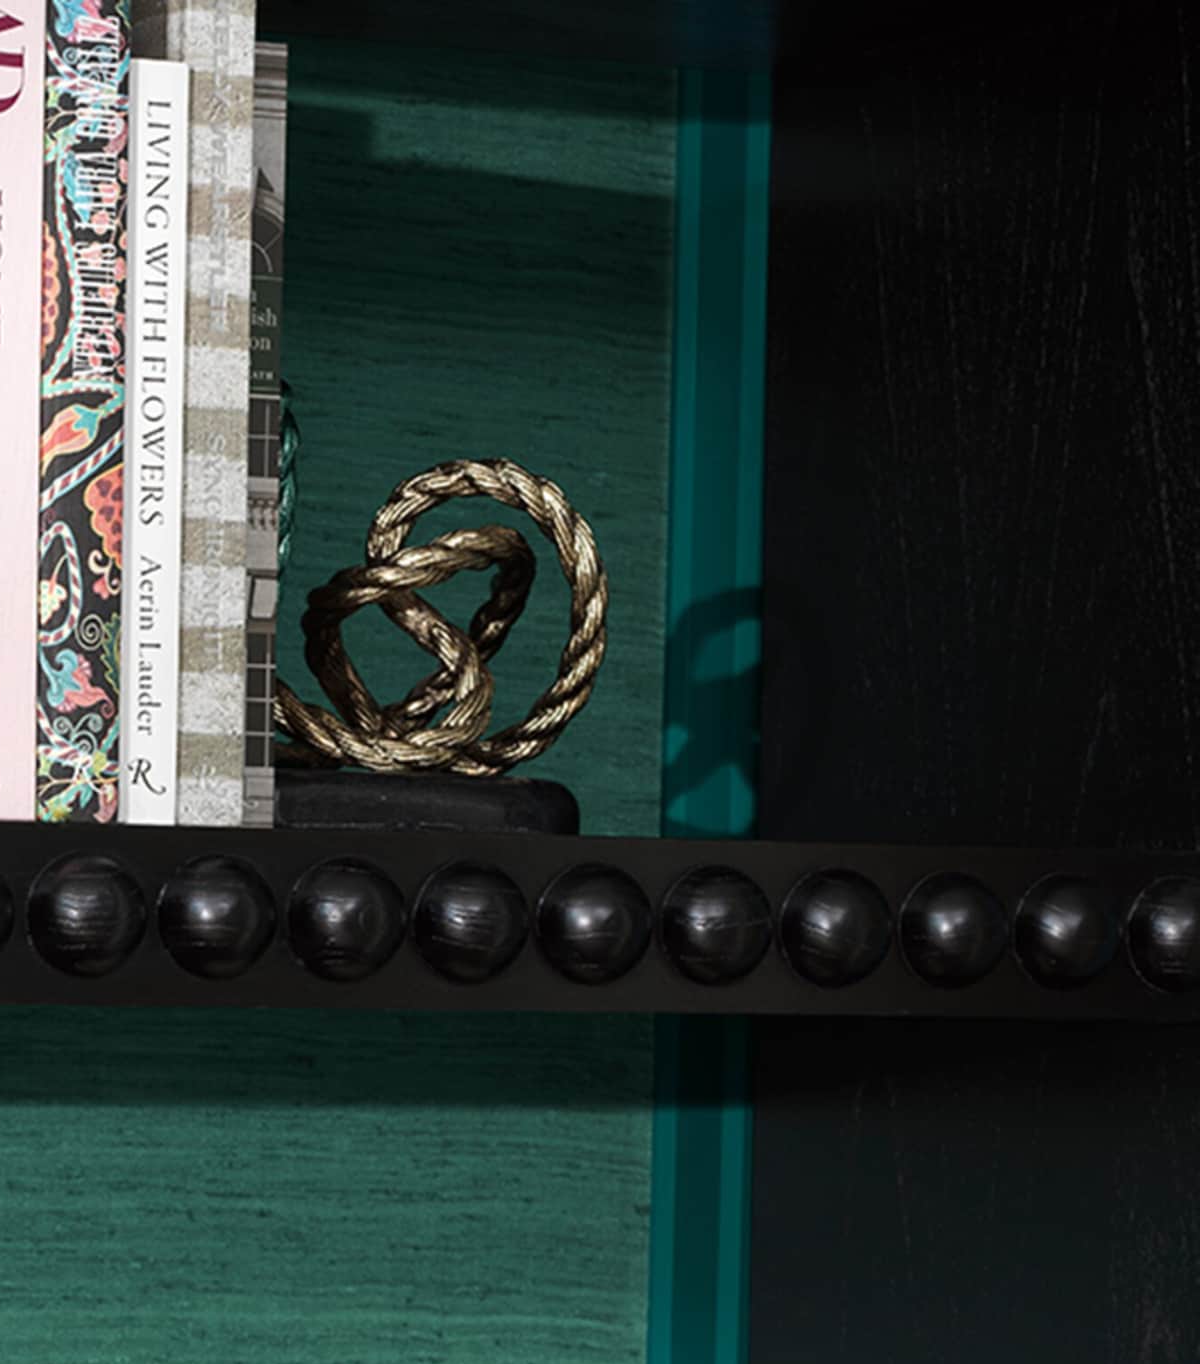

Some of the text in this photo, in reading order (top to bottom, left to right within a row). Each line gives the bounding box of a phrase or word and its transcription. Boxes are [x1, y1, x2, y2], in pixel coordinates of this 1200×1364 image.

[138, 101, 171, 527] LIVING WITH FLOWERS
[136, 555, 163, 736] Aerin Lauder
[126, 757, 167, 795] R
